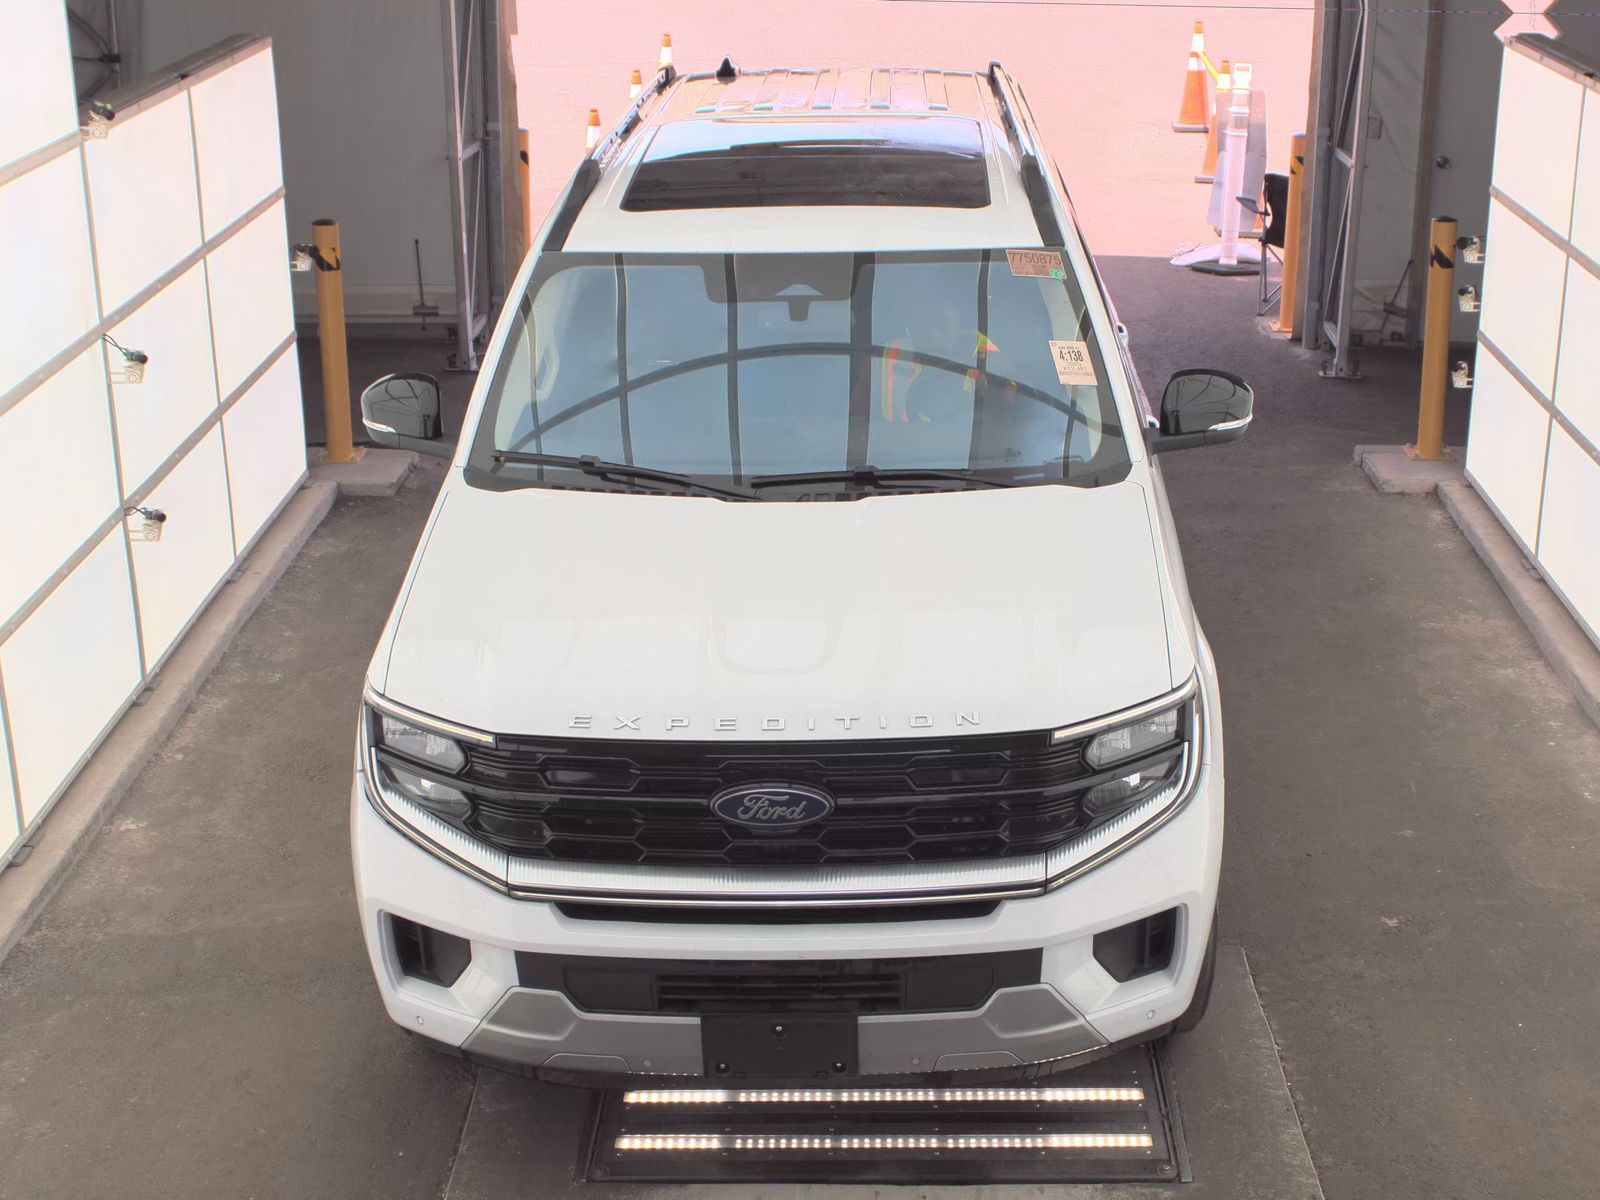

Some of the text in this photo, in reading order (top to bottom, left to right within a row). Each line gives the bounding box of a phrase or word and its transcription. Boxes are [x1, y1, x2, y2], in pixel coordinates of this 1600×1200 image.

[1008, 252, 1062, 265] 7750875
[1059, 350, 1084, 362] 4:138
[568, 711, 981, 731] EXPEDITION
[737, 794, 807, 820] Ford
